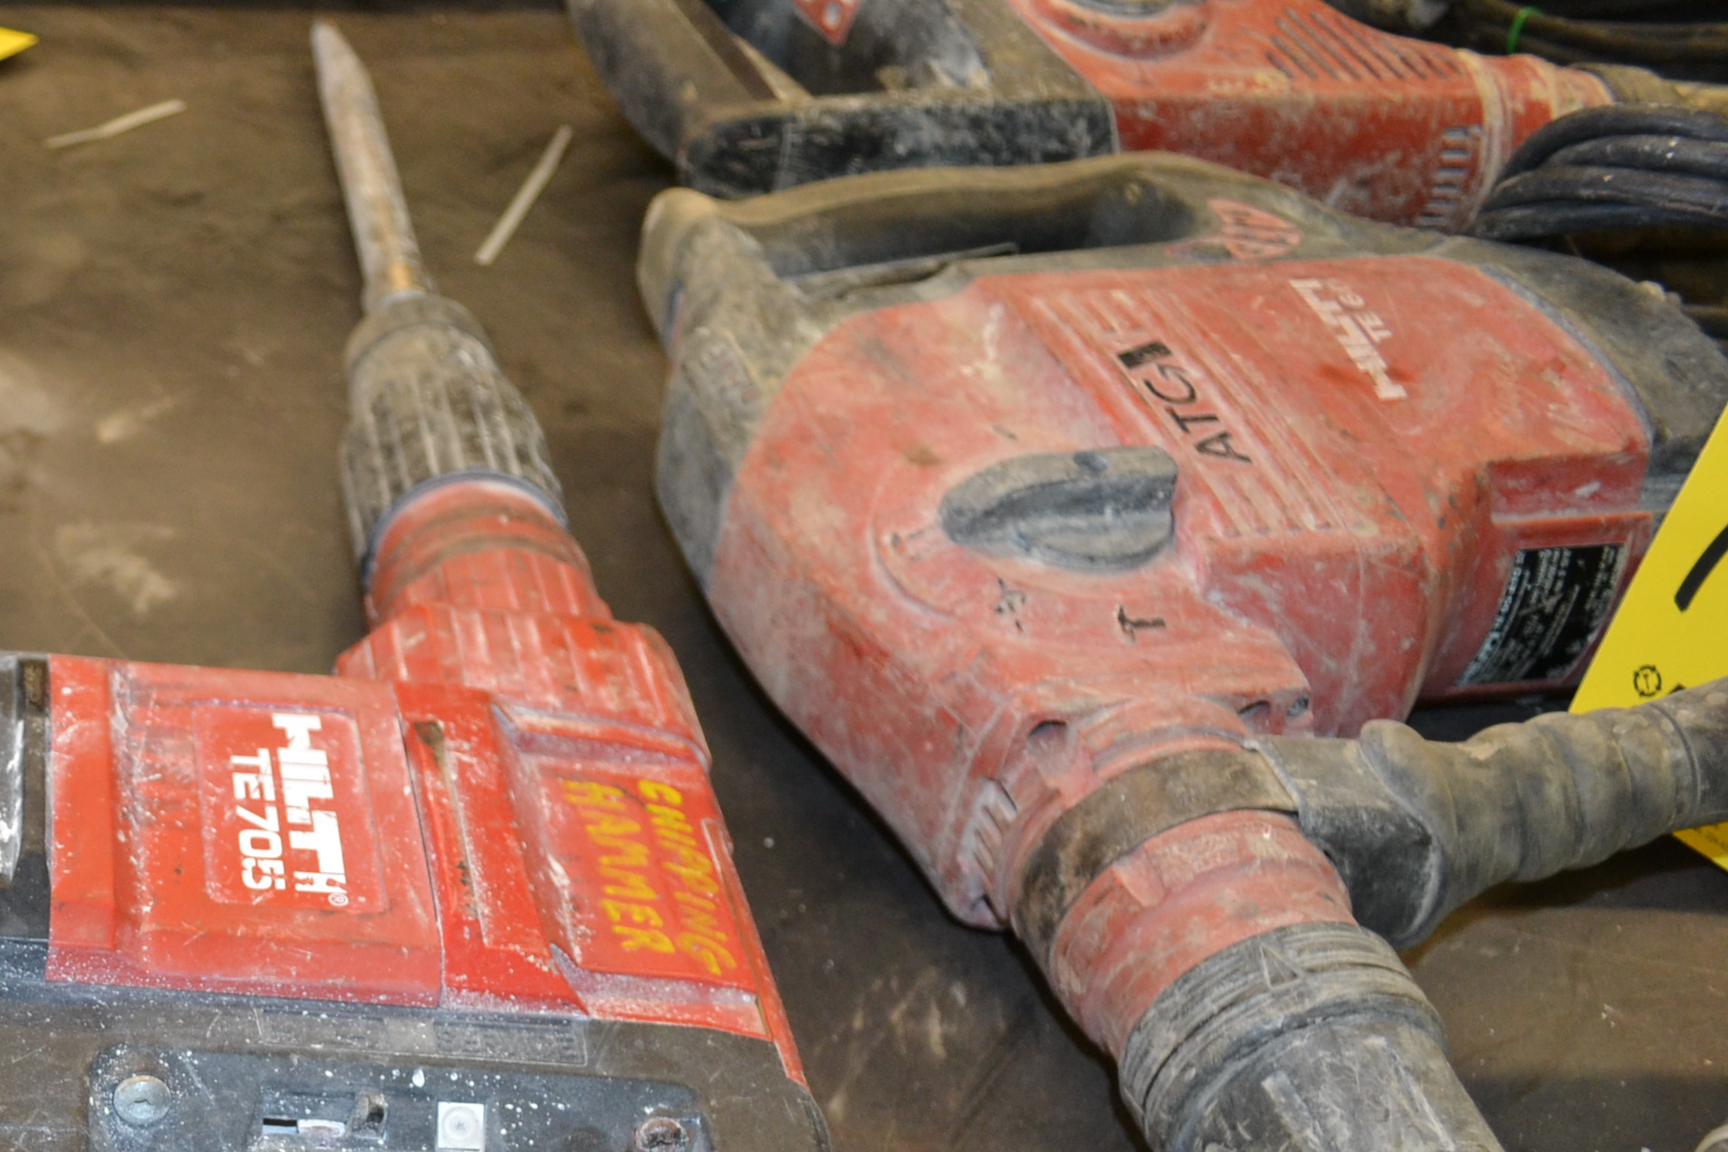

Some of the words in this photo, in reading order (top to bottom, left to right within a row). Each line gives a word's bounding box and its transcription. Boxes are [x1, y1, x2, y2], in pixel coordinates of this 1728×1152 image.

[1288, 278, 1408, 400] HILTI
[272, 713, 349, 894] HILTI
[562, 780, 676, 953] HAMMER
[638, 779, 737, 975] CHIPPING
